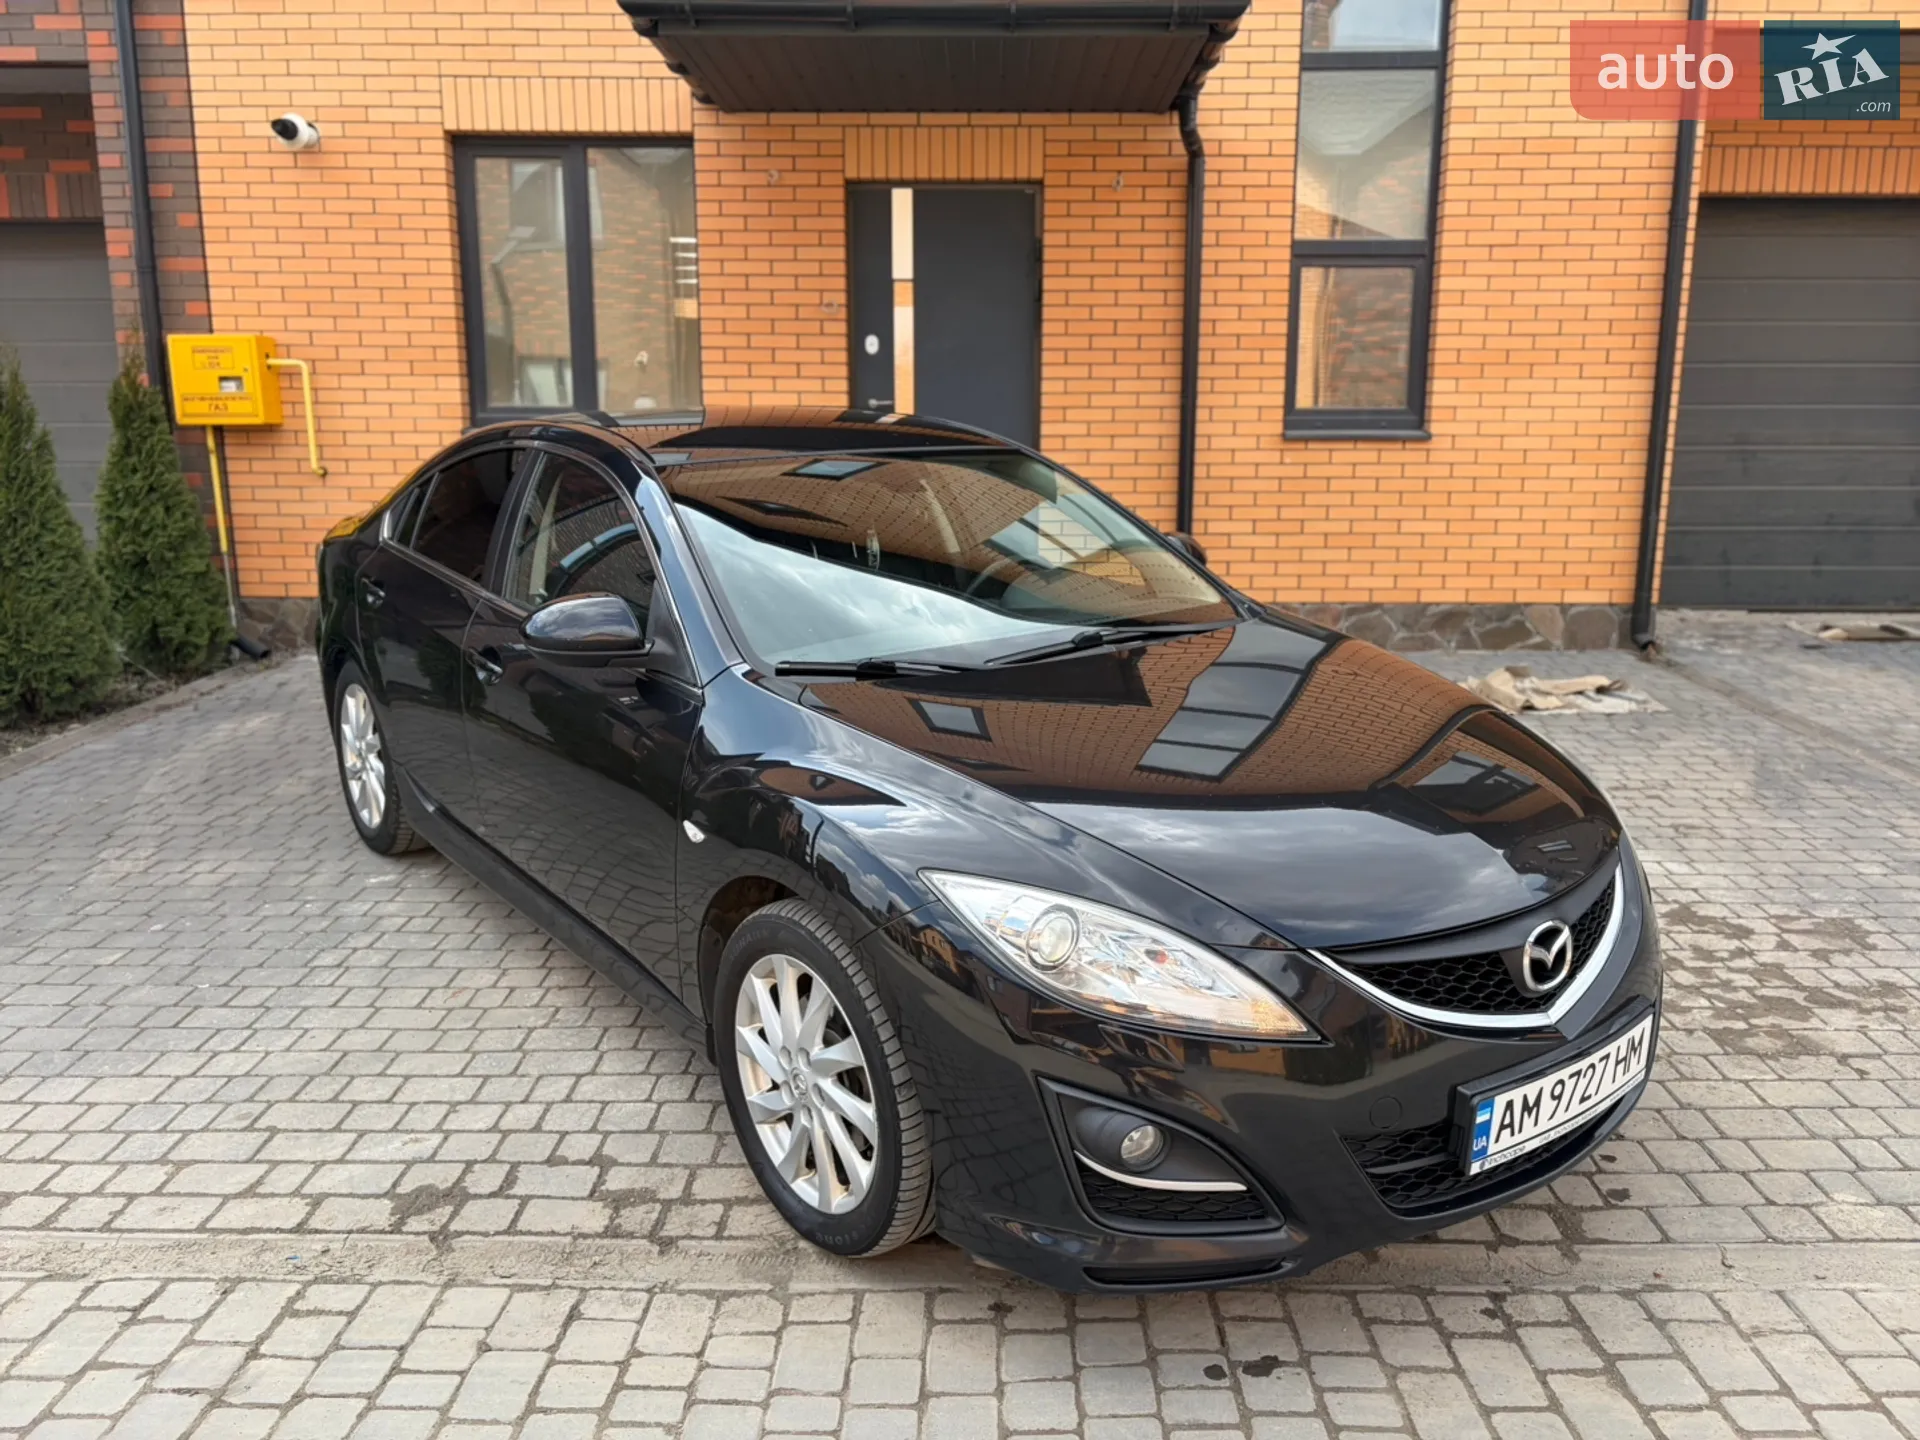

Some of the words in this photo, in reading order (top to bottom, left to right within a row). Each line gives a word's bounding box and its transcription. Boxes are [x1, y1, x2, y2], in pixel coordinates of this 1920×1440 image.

[208, 402, 228, 412] ГАЗ
[1494, 1086, 1544, 1144] AM
[1546, 1052, 1611, 1122] 9727
[1612, 1027, 1645, 1084] HM
[1473, 1136, 1487, 1151] UA
